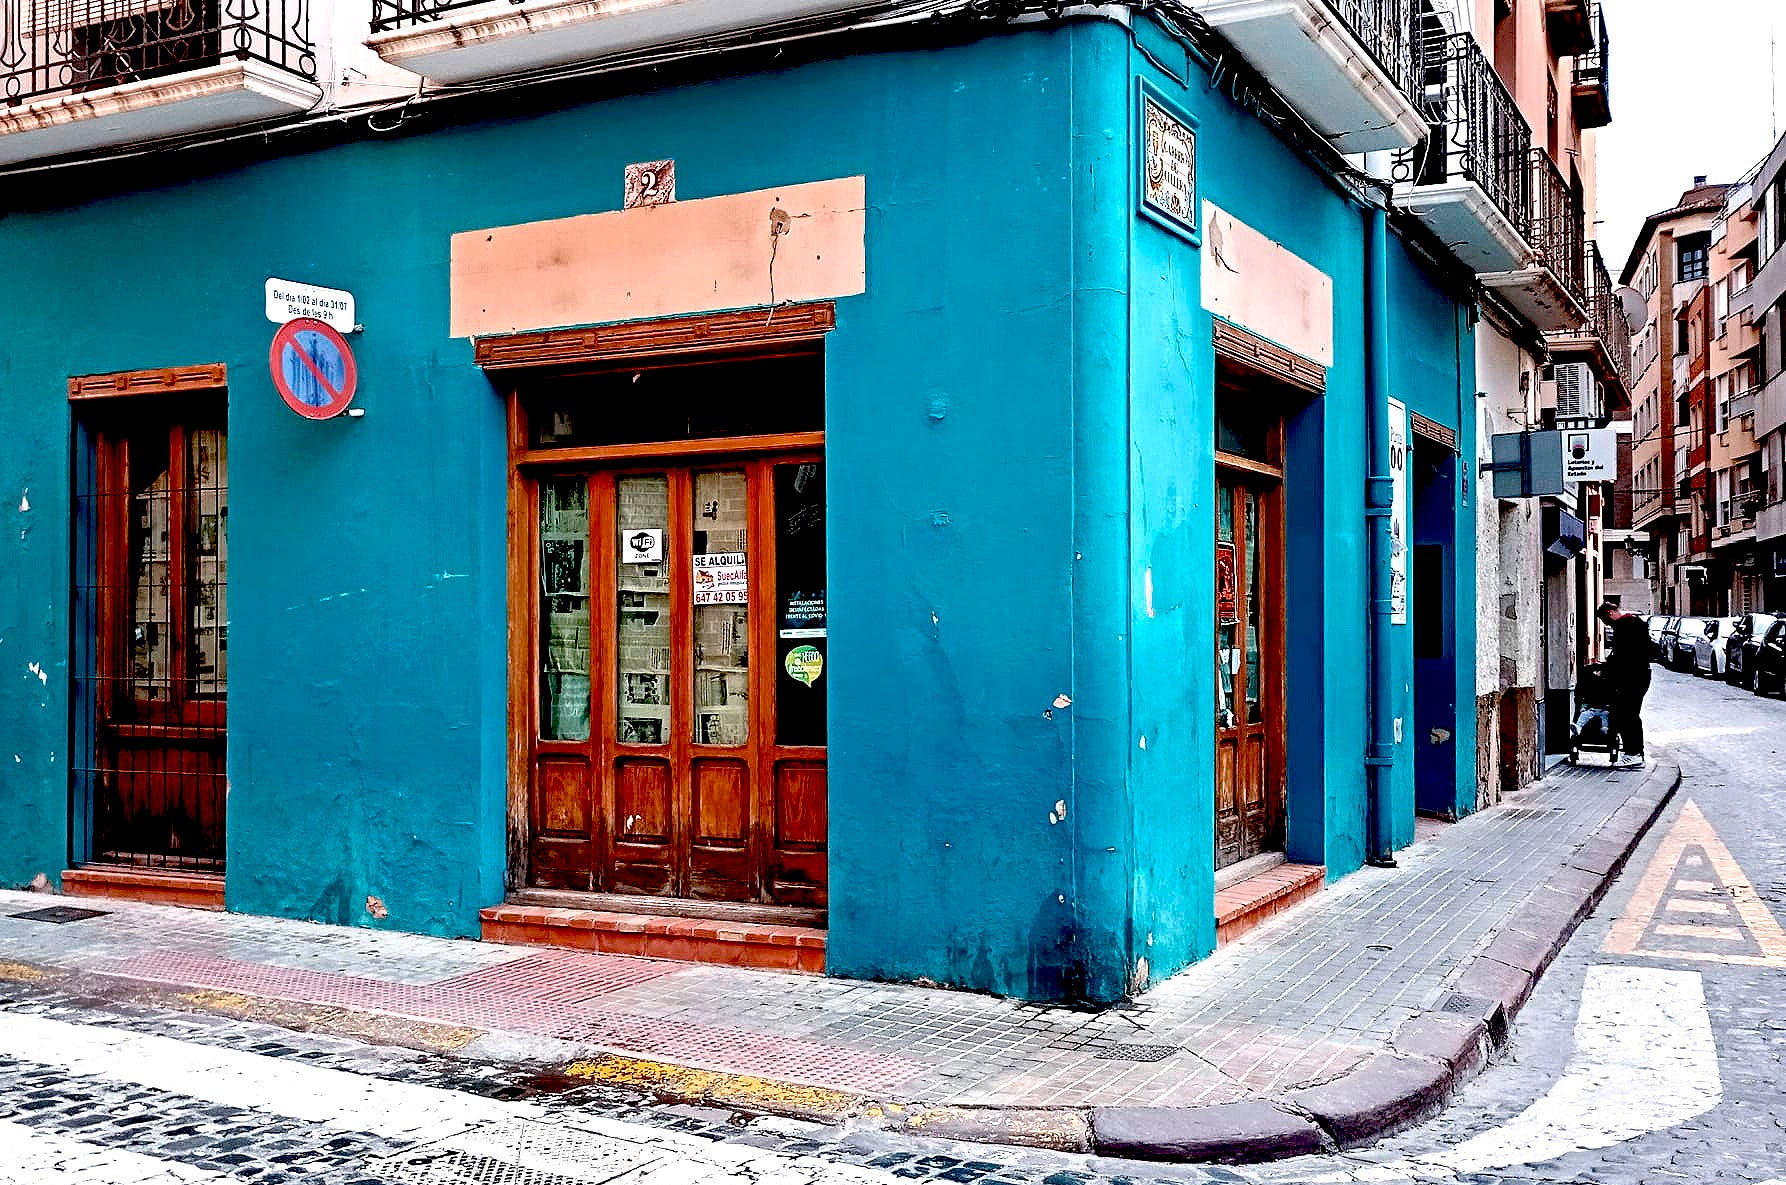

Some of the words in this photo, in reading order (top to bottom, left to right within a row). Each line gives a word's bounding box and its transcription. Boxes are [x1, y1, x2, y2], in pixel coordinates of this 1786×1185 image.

[641, 169, 659, 199] 2
[274, 290, 284, 300] Del
[288, 305, 300, 314] Des
[302, 307, 310, 316] de
[312, 309, 322, 318] les
[695, 557, 706, 566] SE
[695, 593, 710, 603] 647
[713, 592, 724, 603] 42
[725, 591, 736, 602] 05
[738, 591, 749, 602] 95
